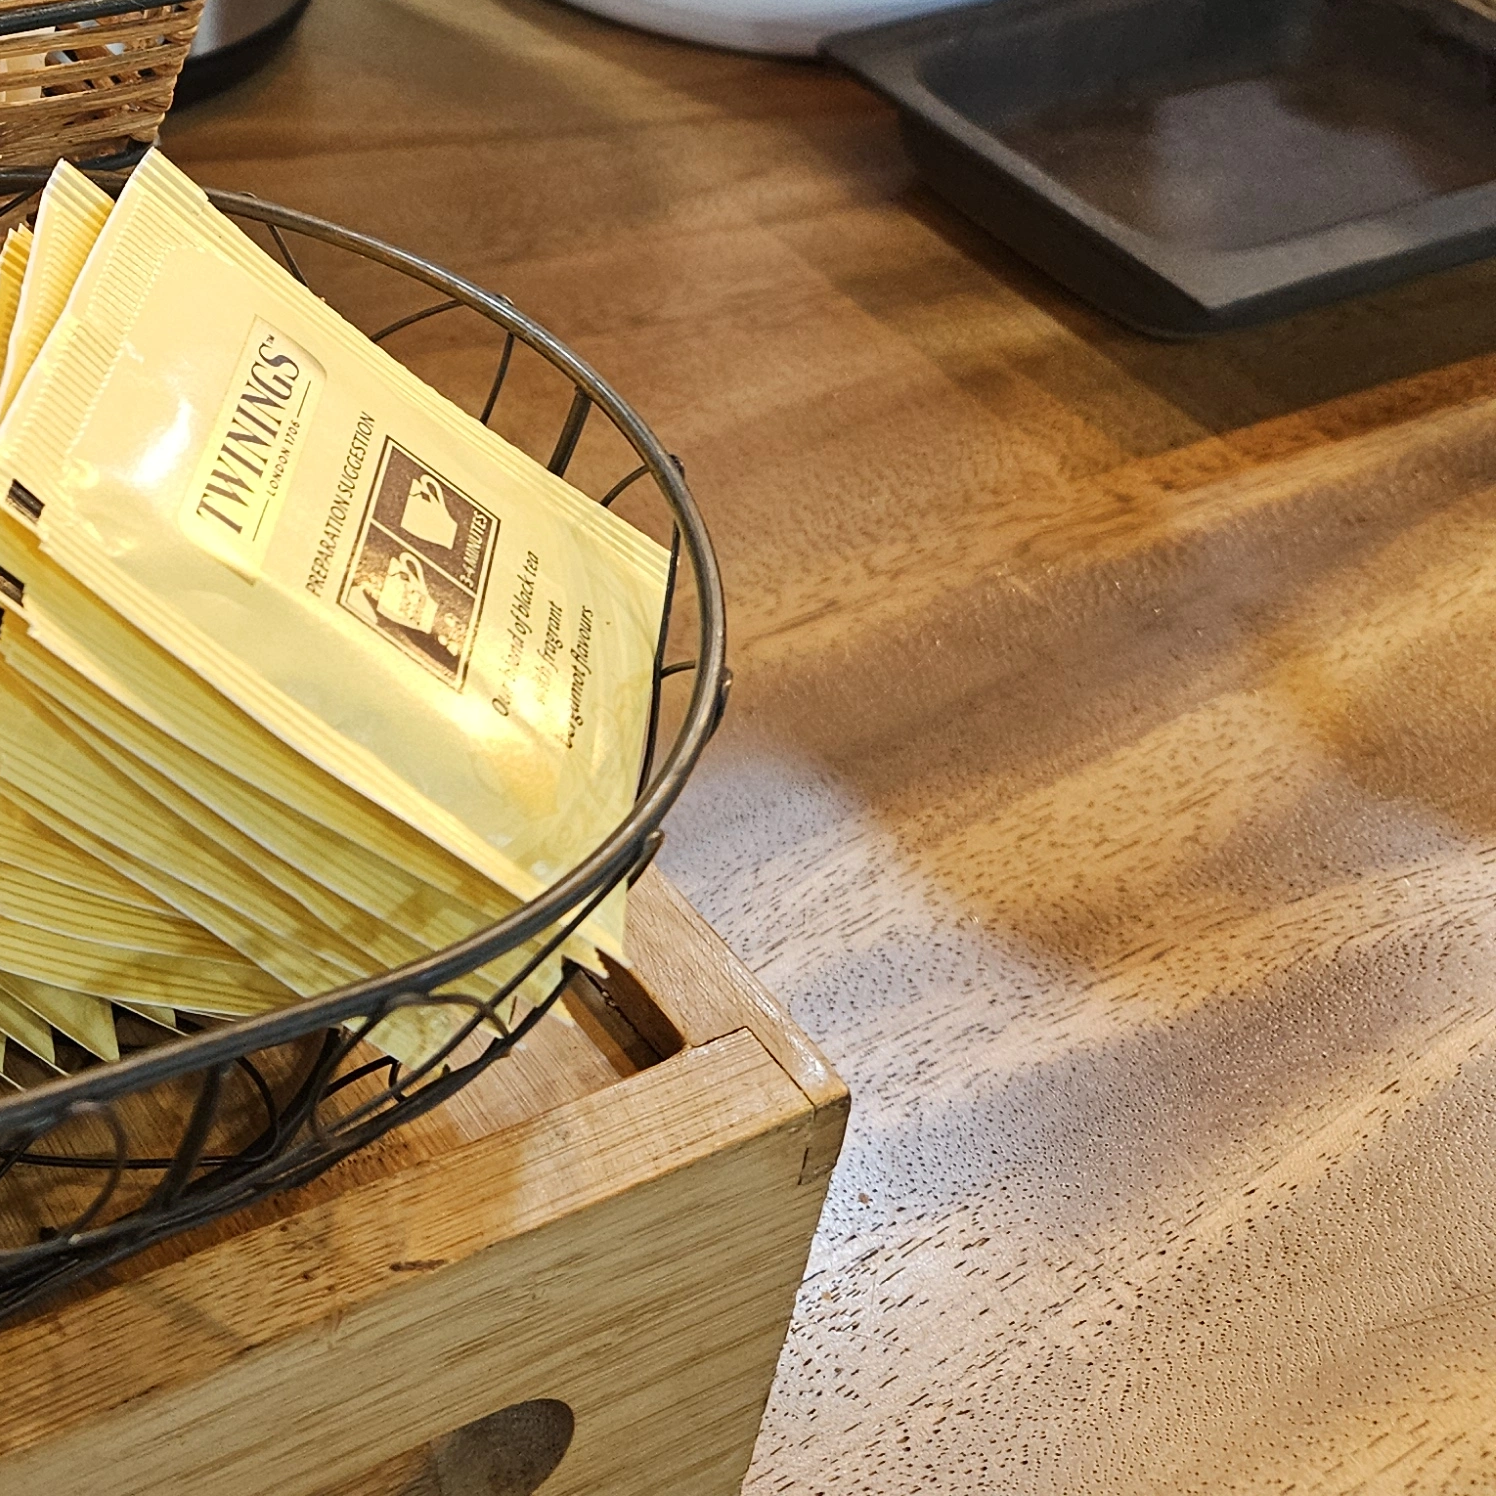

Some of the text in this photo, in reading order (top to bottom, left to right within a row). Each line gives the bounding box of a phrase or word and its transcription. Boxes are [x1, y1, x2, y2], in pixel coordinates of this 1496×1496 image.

[196, 342, 300, 534] TWININGS
[267, 420, 301, 497] LONDON 1706
[306, 411, 376, 598] PREPARATION SUGGESTION
[463, 510, 488, 568] MINUTES
[511, 574, 535, 619] black
[522, 550, 539, 577] tea
[510, 609, 533, 635] of
[537, 599, 563, 673] fragrant
[570, 605, 594, 675] flavours
